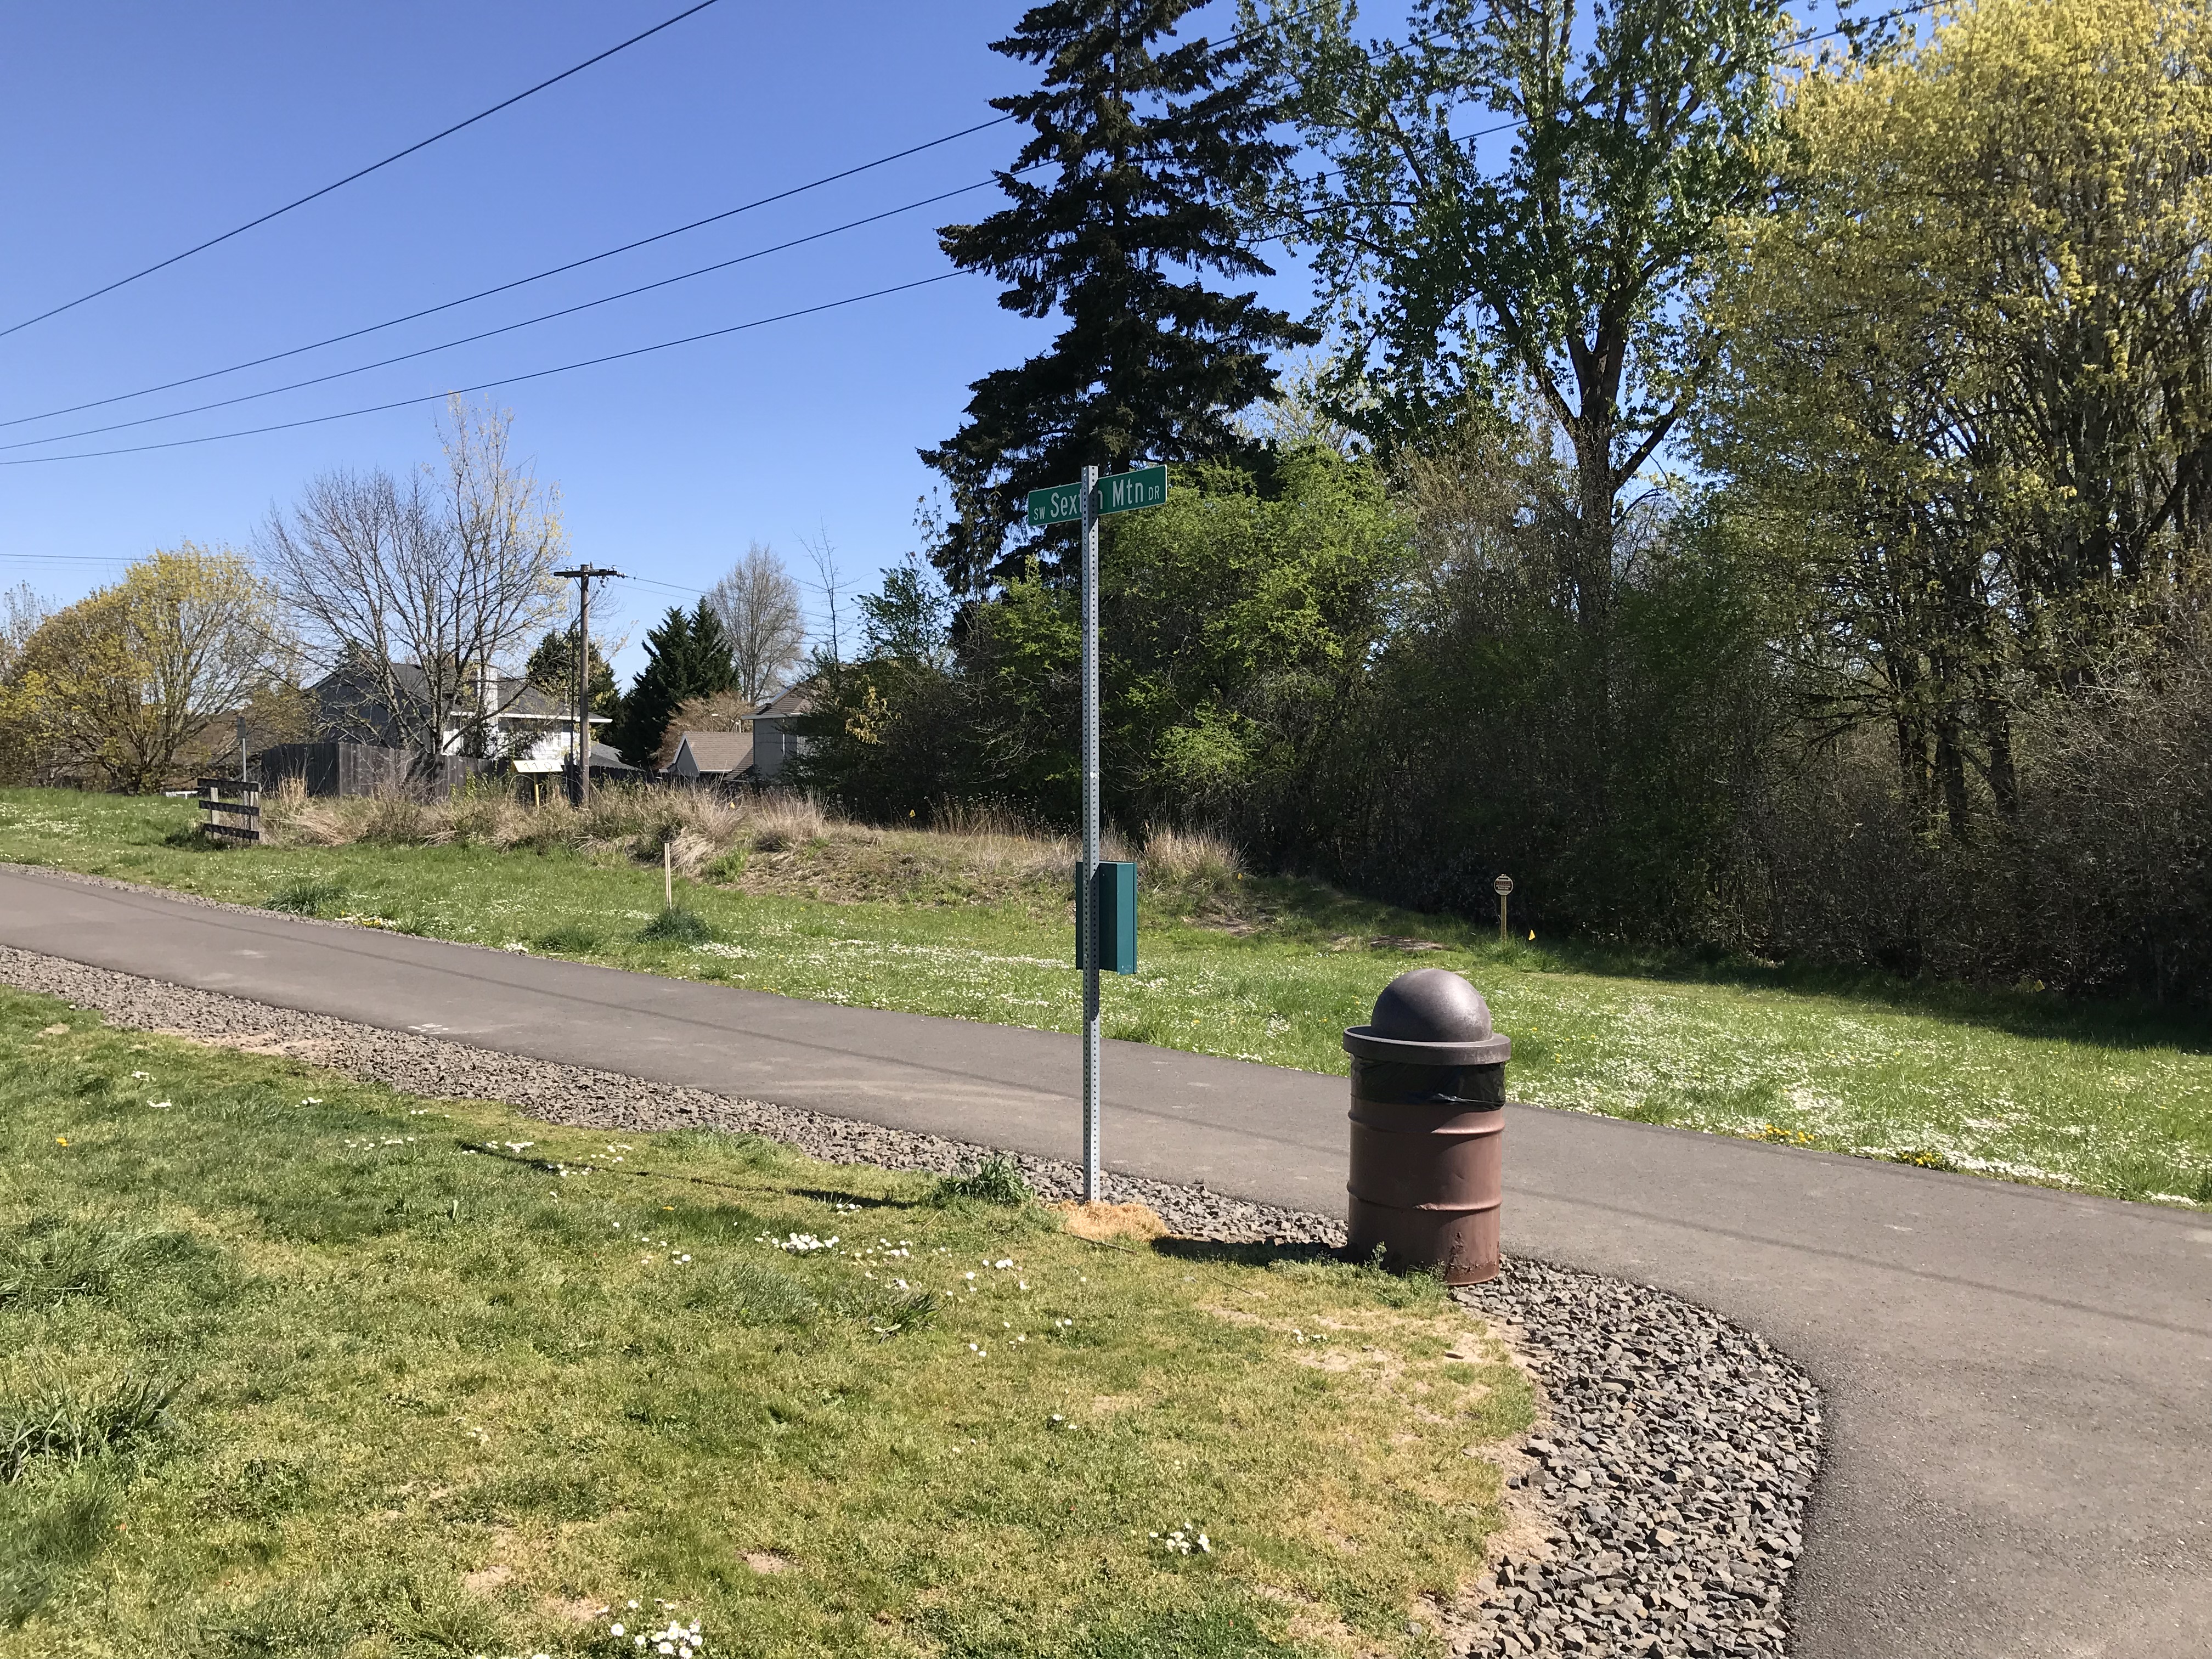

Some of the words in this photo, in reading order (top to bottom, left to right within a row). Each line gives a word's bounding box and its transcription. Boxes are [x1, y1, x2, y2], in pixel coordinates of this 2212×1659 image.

[1034, 506, 1046, 521] SW
[1050, 488, 1103, 518] Sextn
[1113, 478, 1143, 507] Mtn
[1148, 485, 1160, 501] DR
